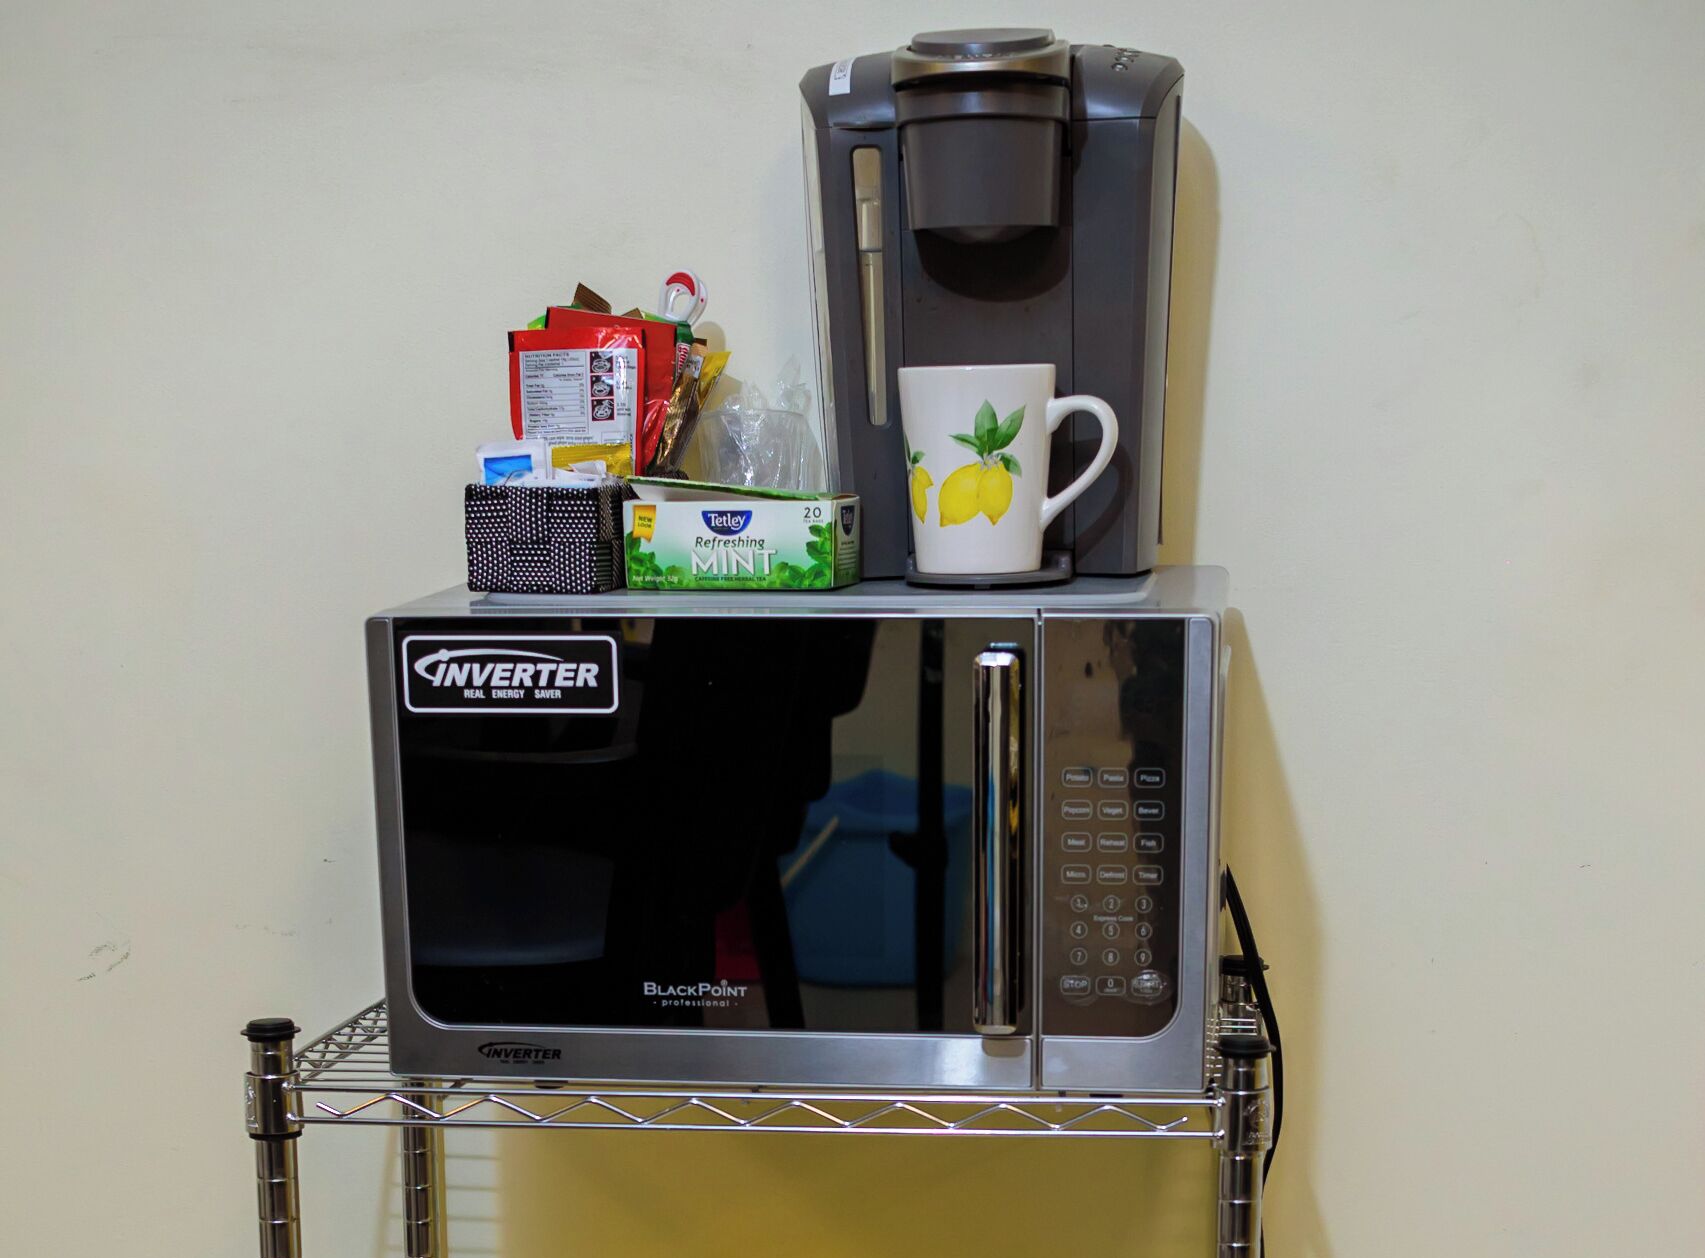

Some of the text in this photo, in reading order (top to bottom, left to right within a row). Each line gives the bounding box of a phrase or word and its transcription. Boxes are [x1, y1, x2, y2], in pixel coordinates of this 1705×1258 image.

[804, 507, 822, 518] 20
[638, 515, 653, 523] NEW
[708, 513, 746, 531] Tetley
[695, 536, 765, 550] Refreshing
[691, 549, 778, 576] MINT
[424, 655, 600, 688] INVERTER
[464, 689, 562, 699] REAL ENERGY SAVER
[1108, 899, 1114, 909] 2
[1140, 899, 1147, 909] 3
[1076, 925, 1082, 934] 4
[1108, 925, 1114, 936] 5
[1140, 926, 1146, 936] 6
[1076, 951, 1082, 961] 7
[1108, 952, 1114, 962] 8
[1140, 952, 1146, 962] 9
[1063, 980, 1088, 988] STOP
[1107, 979, 1114, 988] 0
[661, 999, 730, 1007] professional
[482, 1045, 562, 1060] INVERTER
